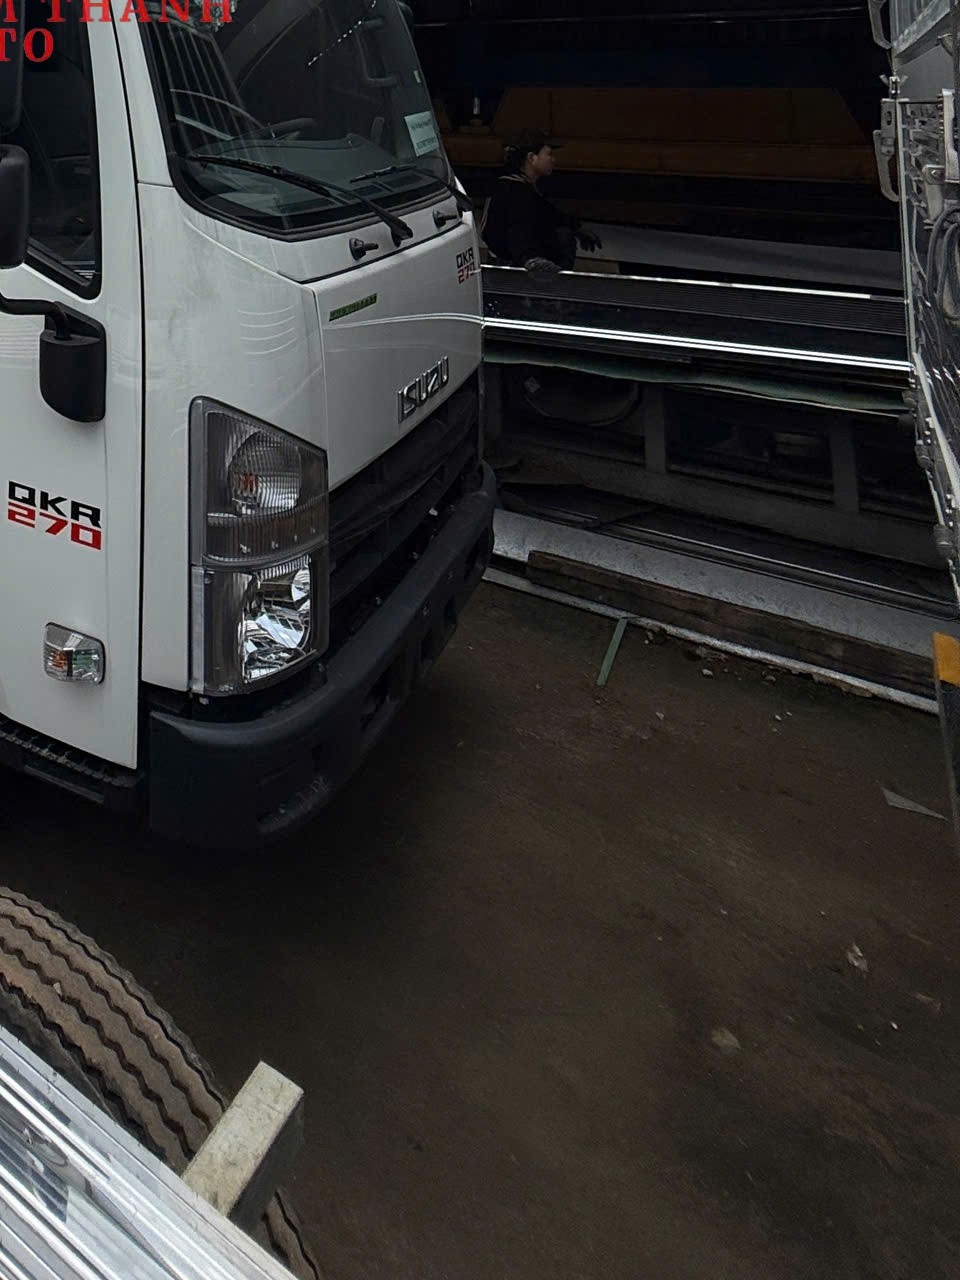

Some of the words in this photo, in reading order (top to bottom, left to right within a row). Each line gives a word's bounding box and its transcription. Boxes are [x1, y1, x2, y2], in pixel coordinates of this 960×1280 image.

[456, 246, 474, 269] QKR
[397, 355, 449, 424] ISUZU
[7, 501, 102, 550] 270
[8, 480, 102, 528] QKR
